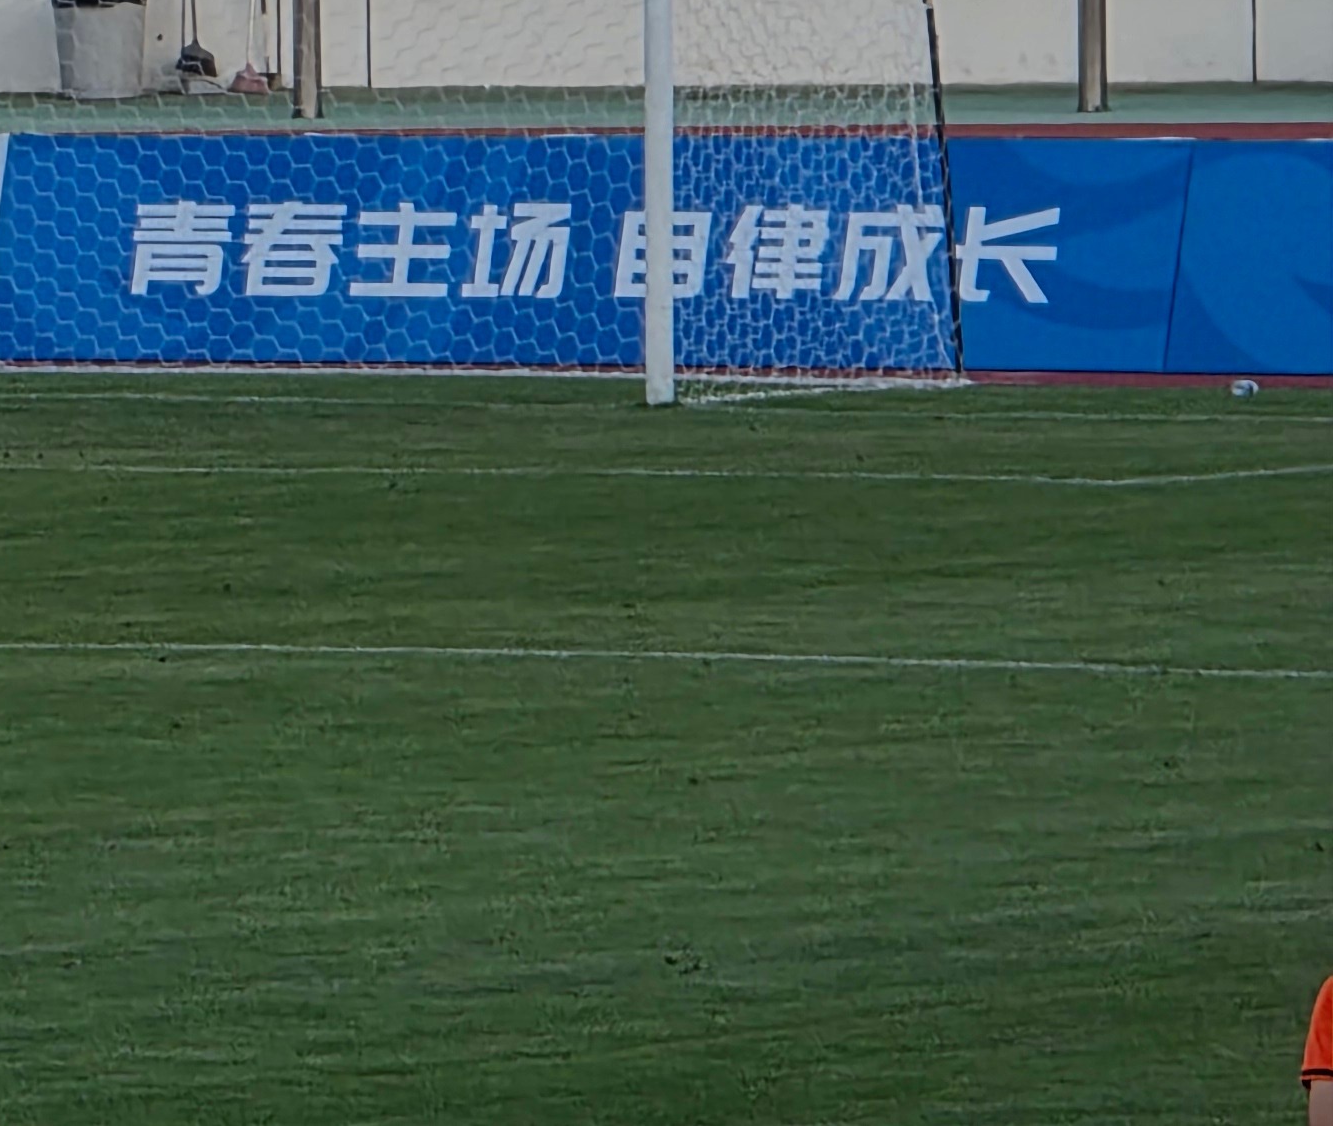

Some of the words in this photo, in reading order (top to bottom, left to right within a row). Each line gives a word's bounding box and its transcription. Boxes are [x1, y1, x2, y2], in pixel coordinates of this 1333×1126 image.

[130, 200, 572, 299] 青春主场
[614, 204, 1061, 304] 自律成长
